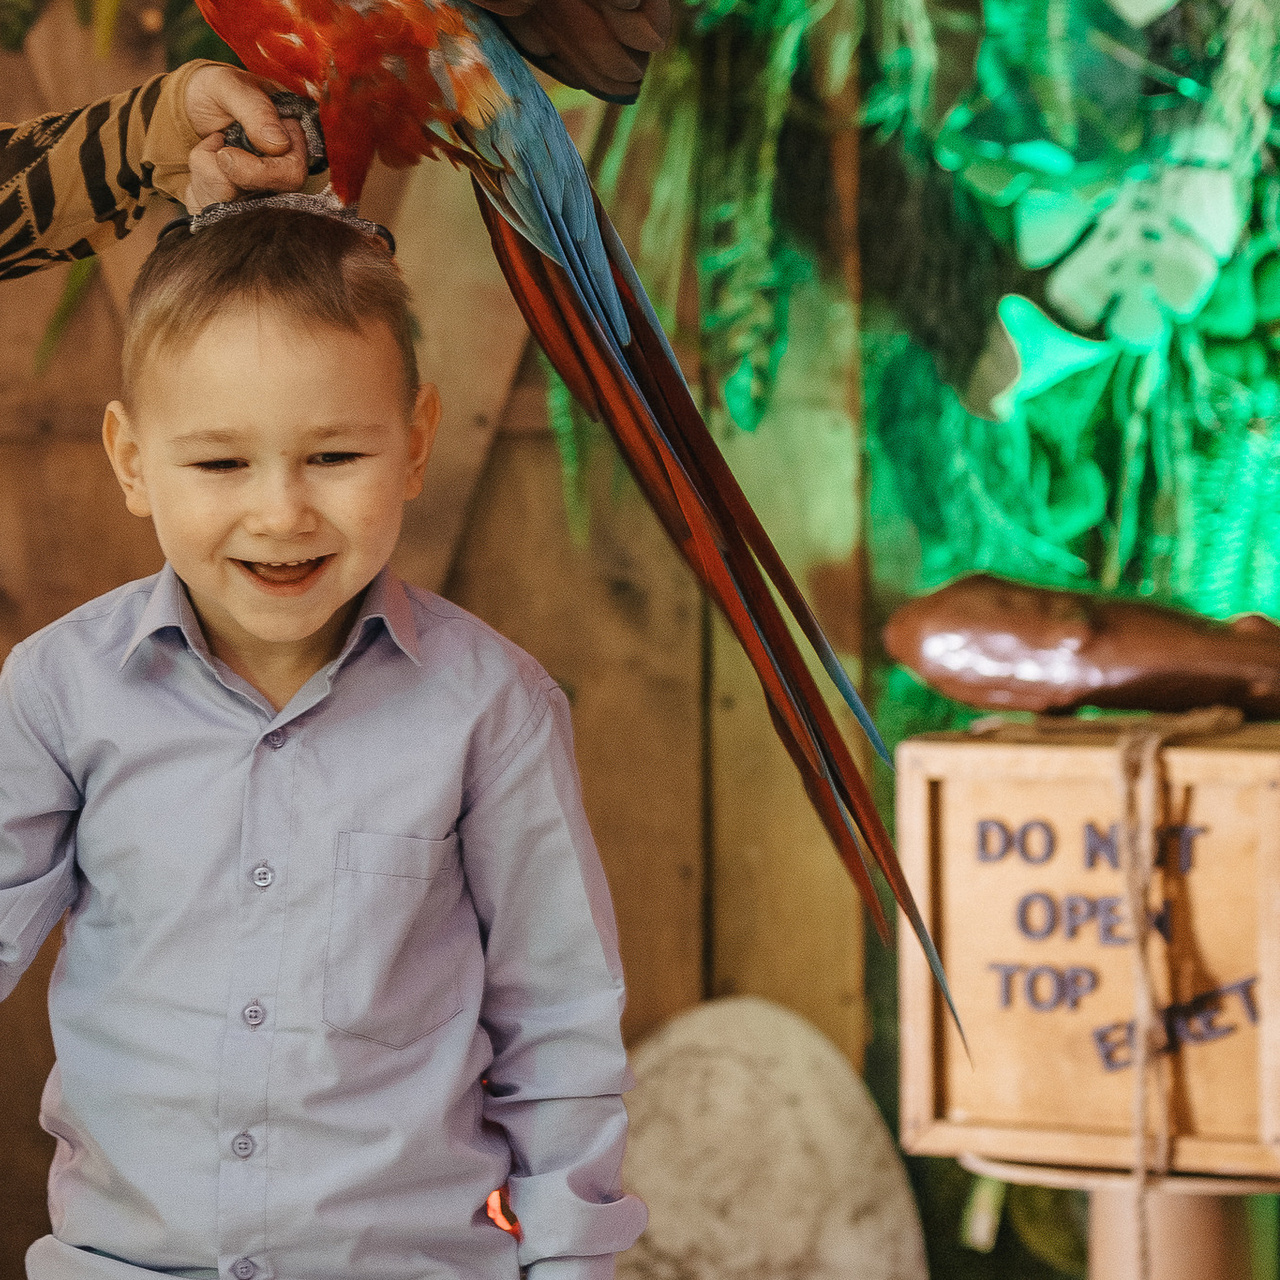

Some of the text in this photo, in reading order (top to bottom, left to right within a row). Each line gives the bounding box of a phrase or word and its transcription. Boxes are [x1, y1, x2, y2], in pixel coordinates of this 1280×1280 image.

[976, 818, 1210, 875] DO NT
[988, 963, 1100, 1012] TOP
